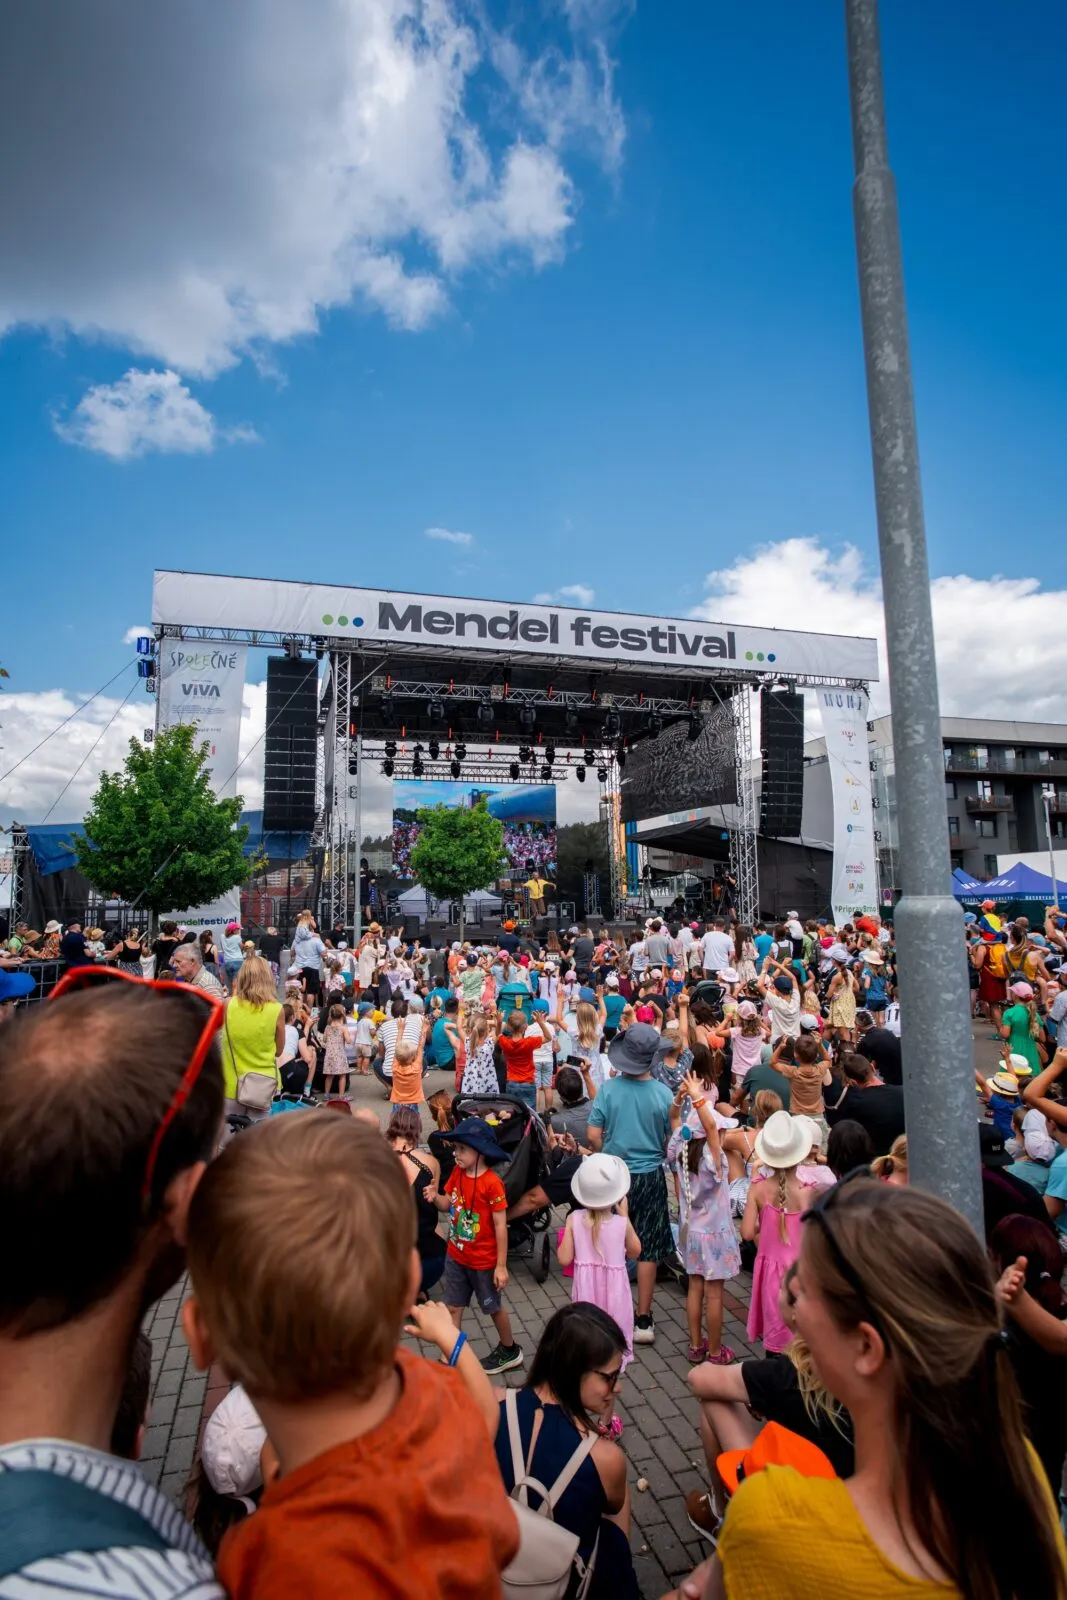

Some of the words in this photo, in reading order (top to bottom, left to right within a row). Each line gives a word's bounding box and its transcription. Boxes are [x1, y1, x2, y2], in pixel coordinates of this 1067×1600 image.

[379, 602, 558, 643] Mendel
[571, 617, 735, 659] festival
[824, 693, 862, 710] MUNI
